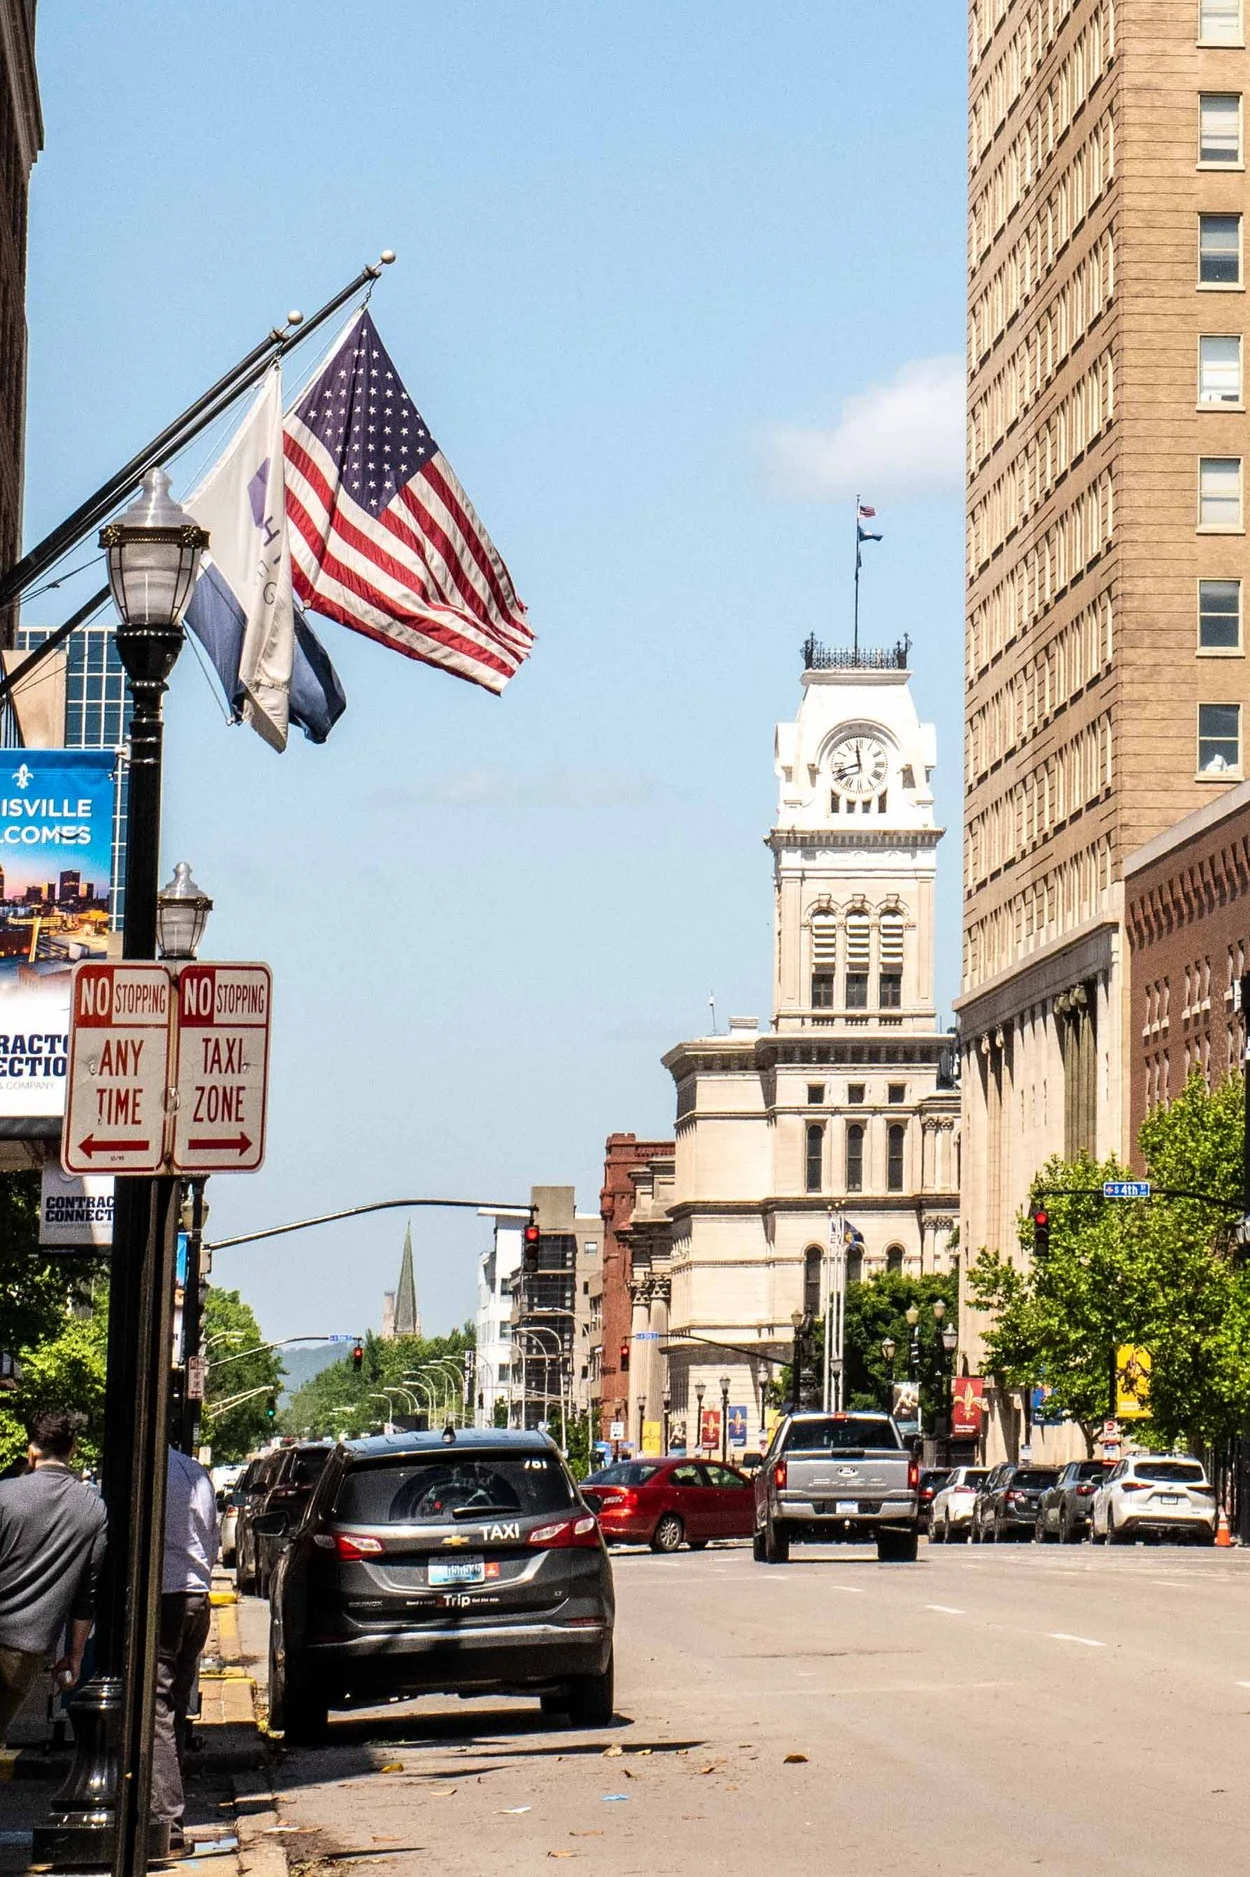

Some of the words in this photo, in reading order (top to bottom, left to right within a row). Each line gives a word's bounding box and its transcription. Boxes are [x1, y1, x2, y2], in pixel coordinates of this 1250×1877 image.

[0, 825, 91, 844] COMES
[81, 977, 110, 1017] NO
[115, 983, 166, 1014] STOPPING
[184, 977, 213, 1017] NO
[216, 983, 265, 1014] STOPPING
[99, 1039, 144, 1077] ANY
[202, 1037, 243, 1075] TAXI
[97, 1088, 143, 1126] TIME
[193, 1085, 246, 1123] ZONE
[1121, 1184, 1139, 1195] 4th
[479, 1523, 520, 1541] TAXI
[443, 1594, 471, 1608] Trip
